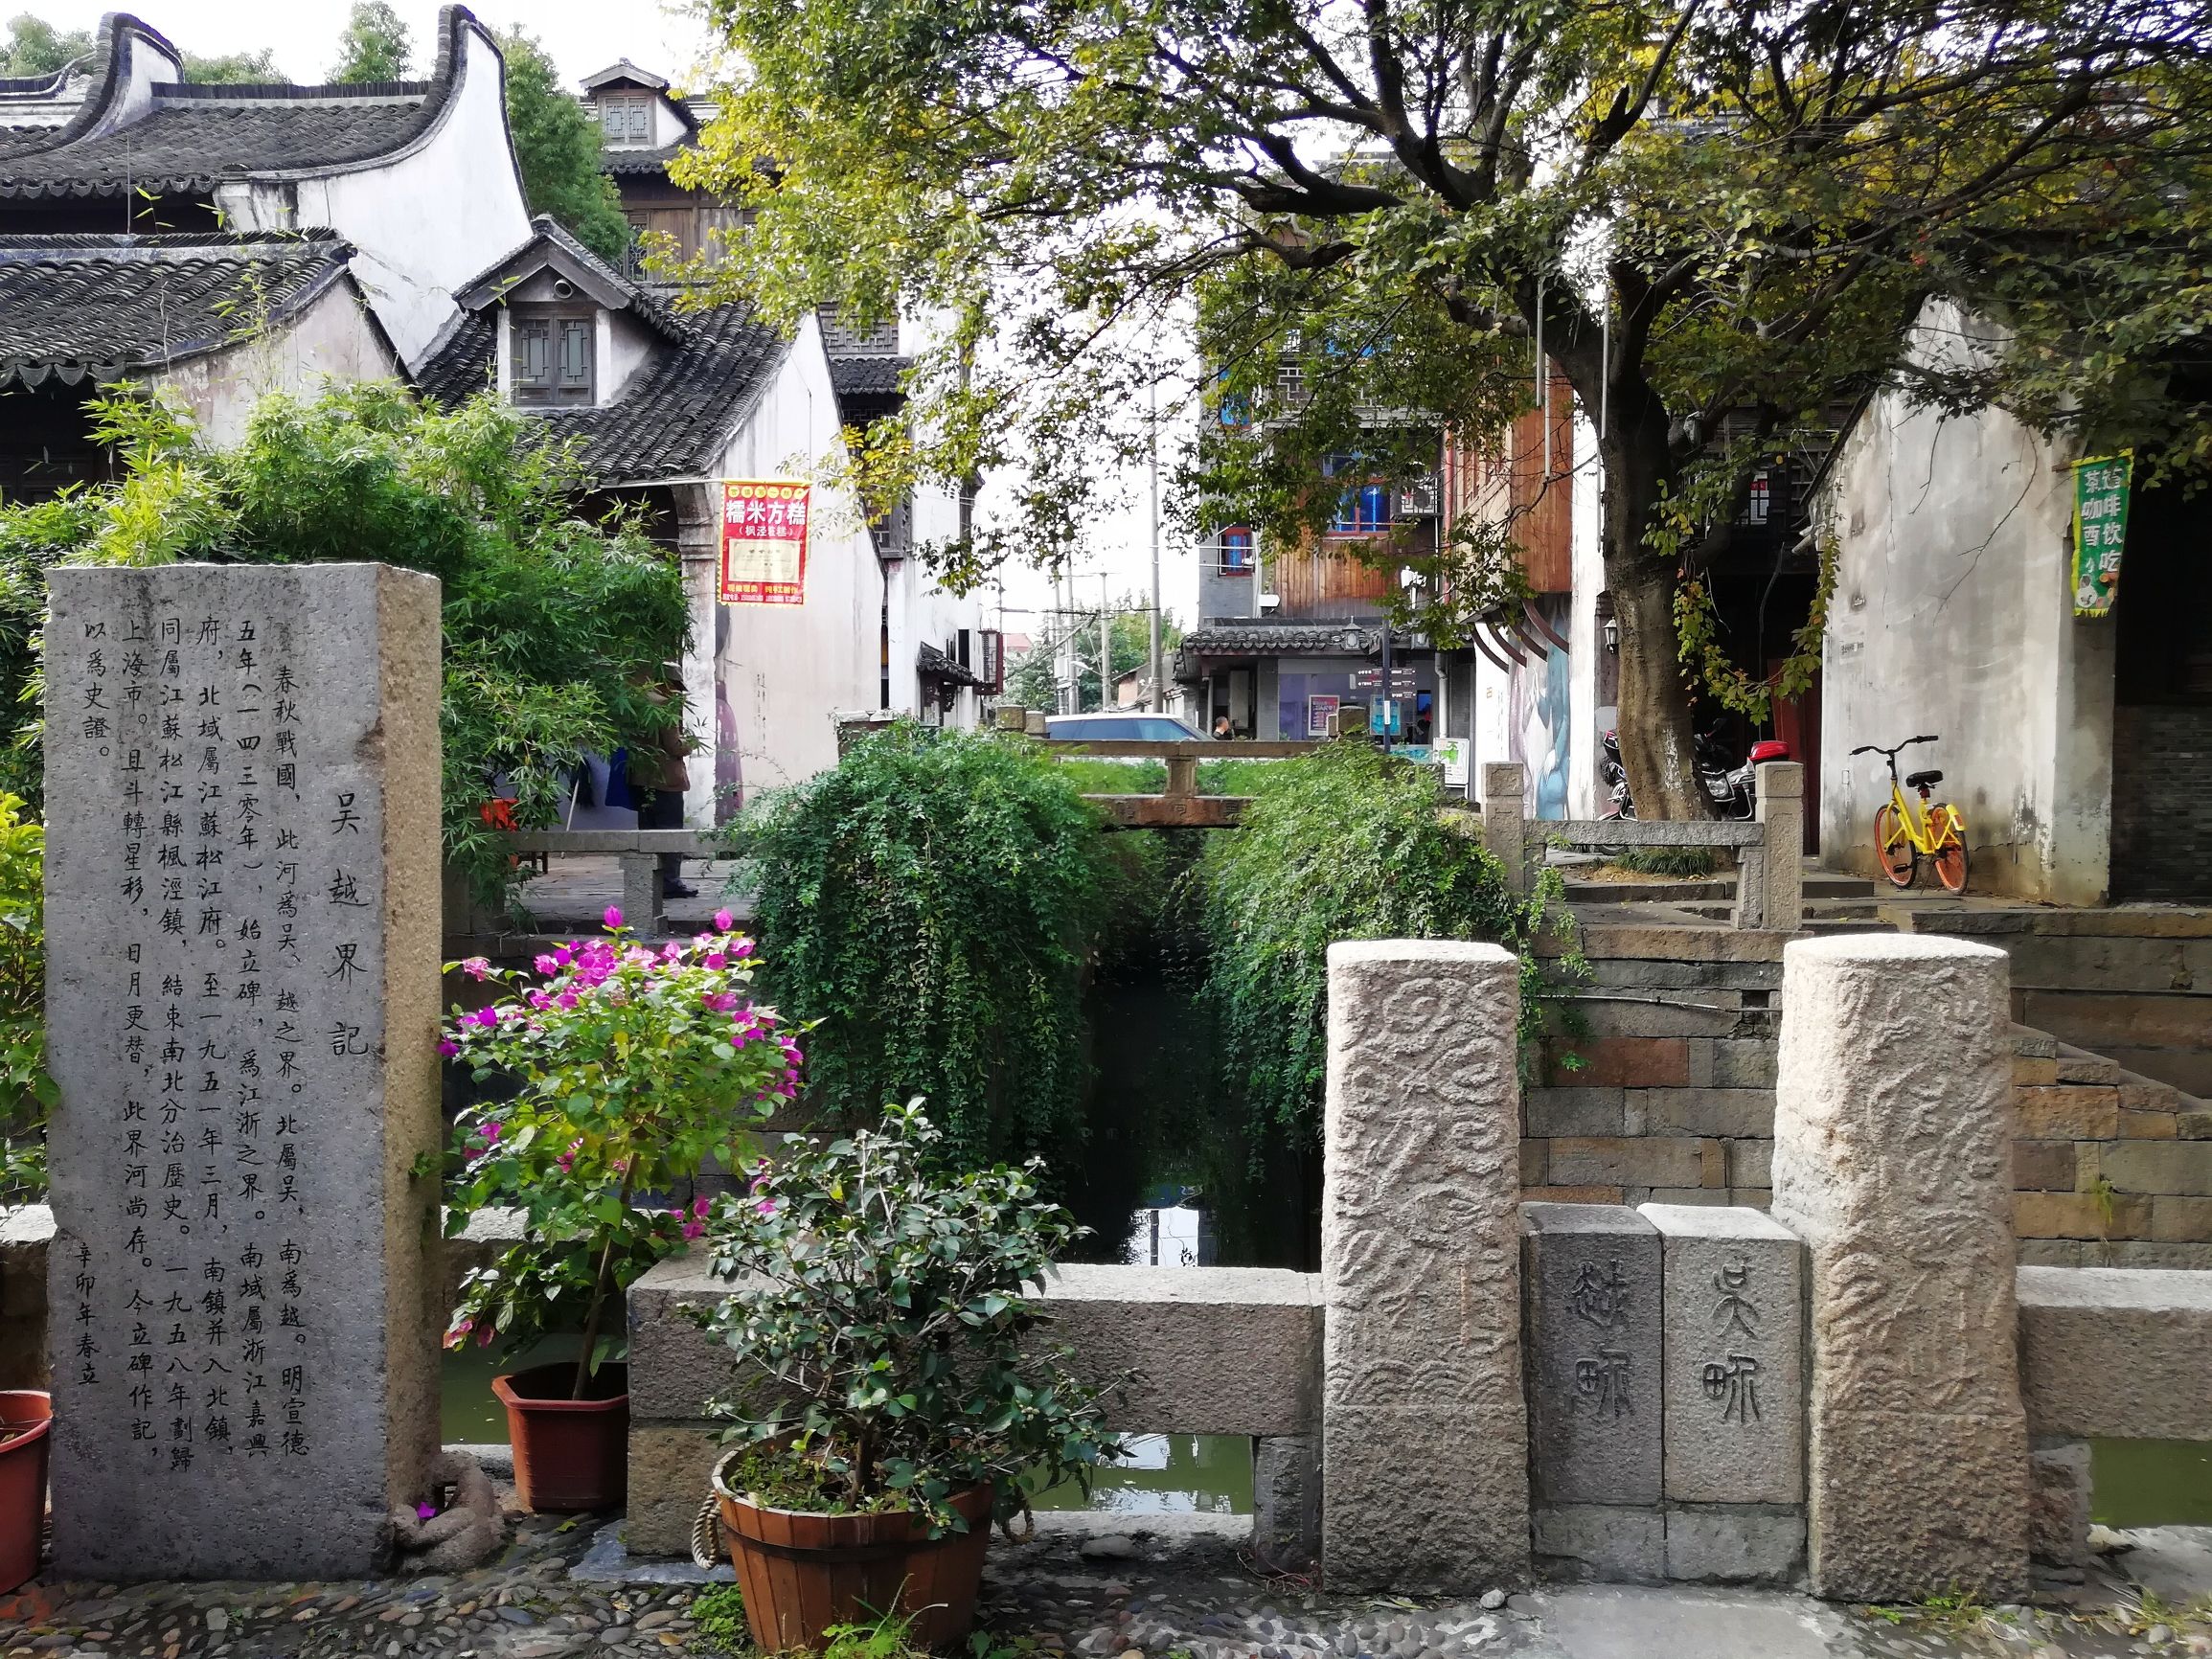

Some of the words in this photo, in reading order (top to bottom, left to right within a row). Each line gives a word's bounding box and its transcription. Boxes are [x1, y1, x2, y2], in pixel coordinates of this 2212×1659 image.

[725, 499, 807, 526] 糯米方糕
[2082, 494, 2121, 520] 咖啡
[74, 1241, 101, 1386] 辛卯年春立
